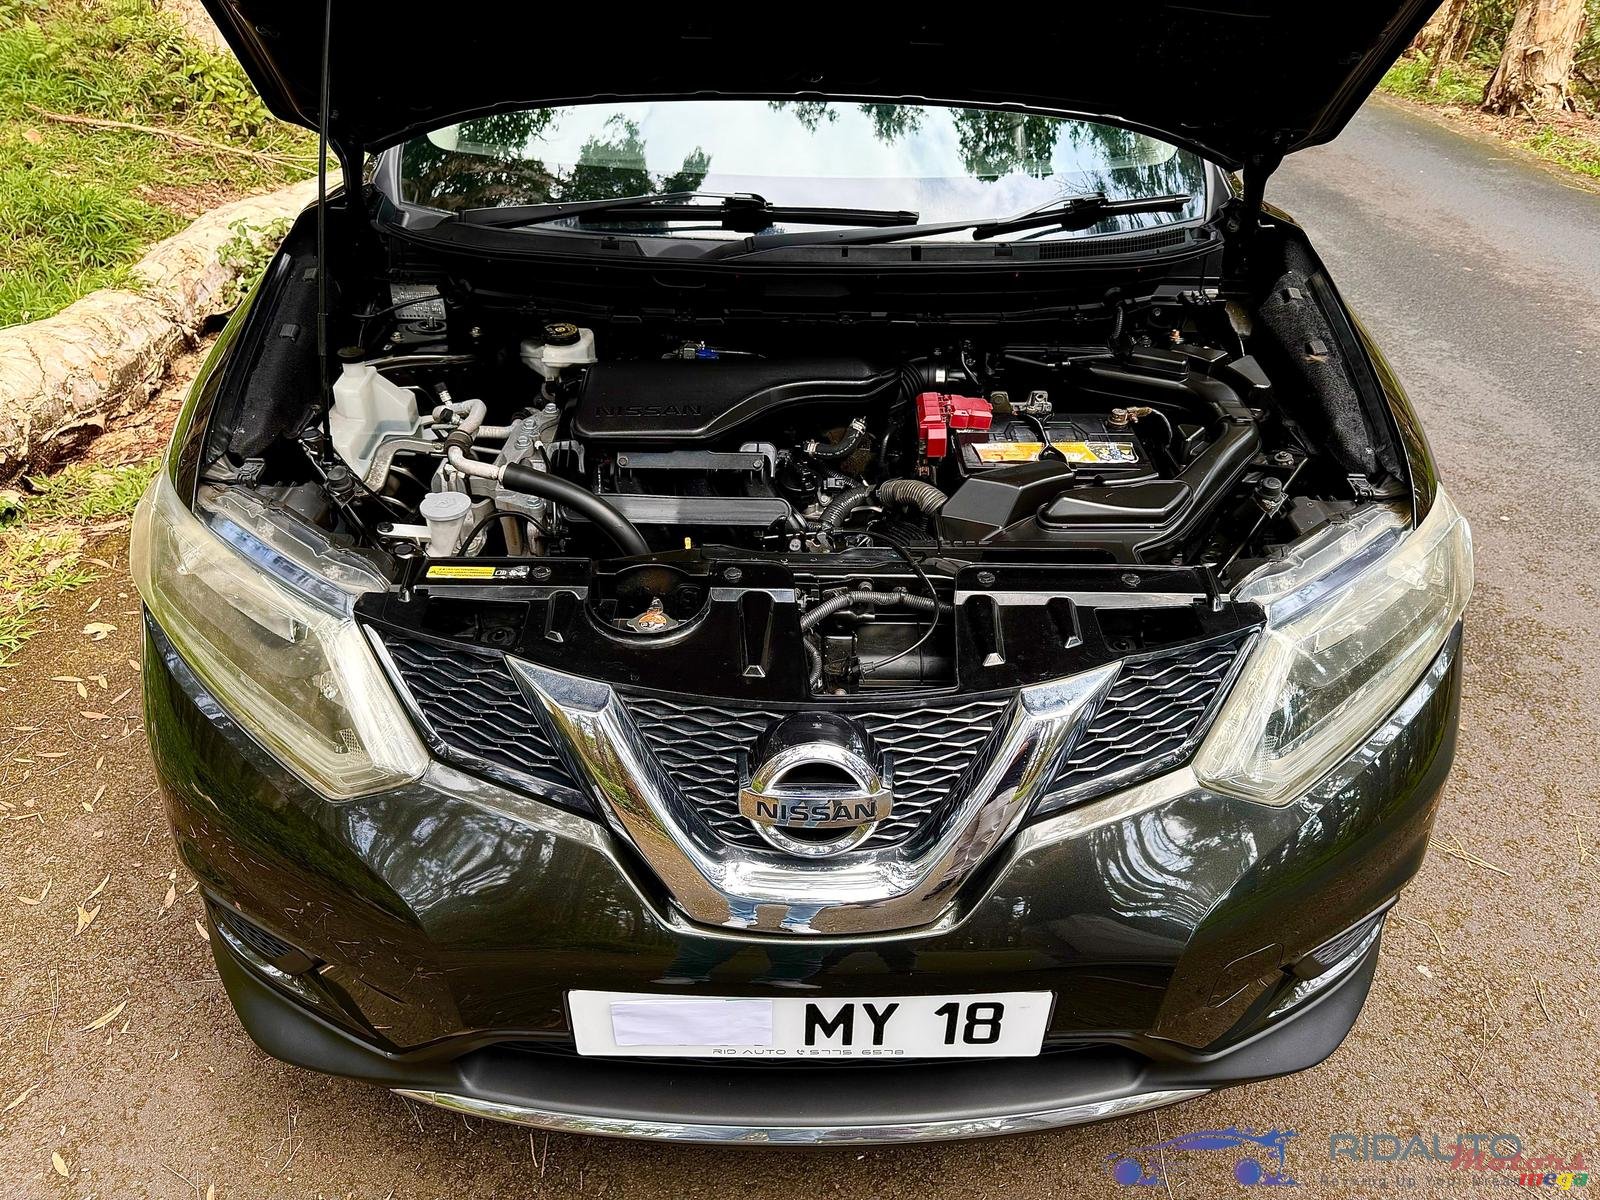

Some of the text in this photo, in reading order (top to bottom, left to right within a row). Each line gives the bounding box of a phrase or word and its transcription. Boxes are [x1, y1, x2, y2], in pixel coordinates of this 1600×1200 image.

[594, 405, 702, 417] NISSAN
[756, 800, 877, 822] NISSAN
[804, 1002, 1005, 1046] MY 18
